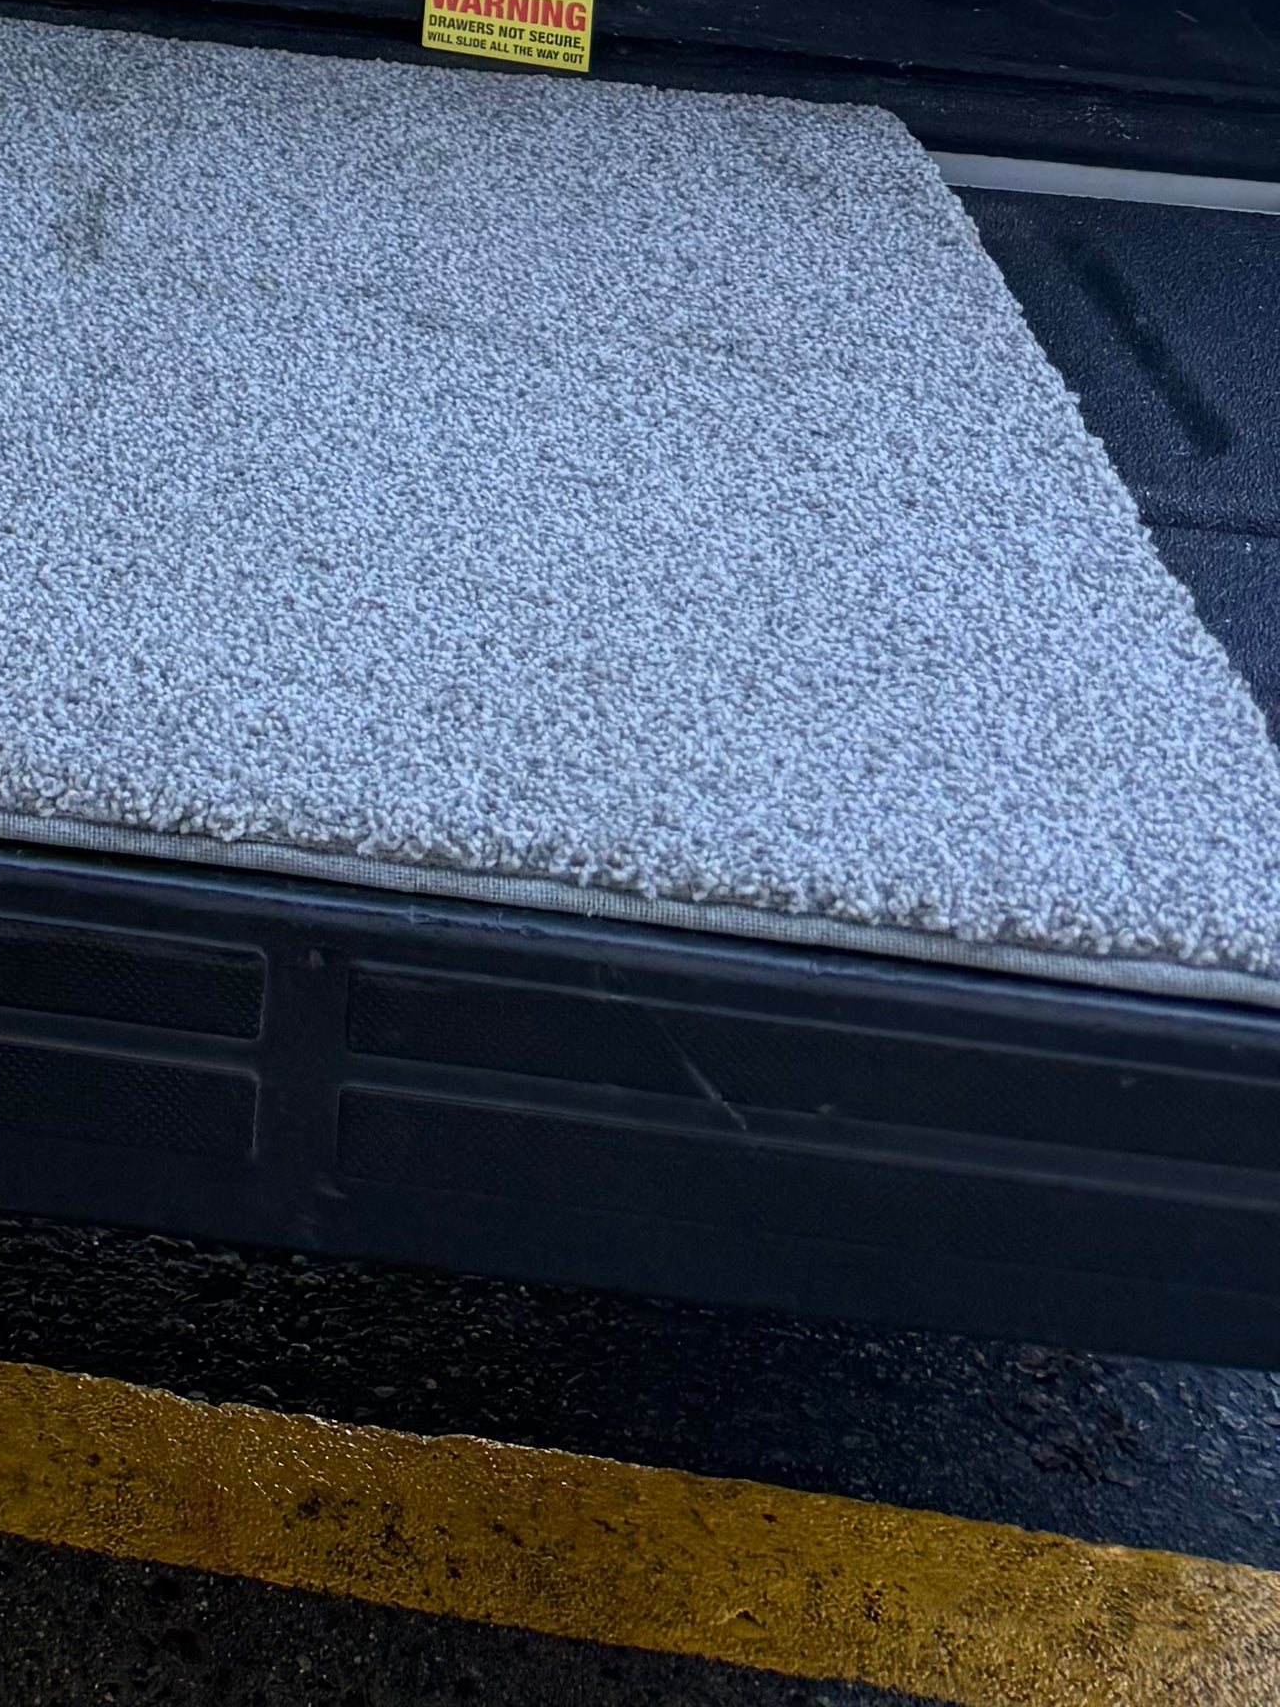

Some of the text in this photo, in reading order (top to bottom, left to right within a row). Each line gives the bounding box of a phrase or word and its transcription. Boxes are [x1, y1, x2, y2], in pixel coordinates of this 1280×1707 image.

[427, 30, 584, 65] WILL SLIDE ALL THE WAY OUT
[429, 14, 585, 52] DRAWERS NOT SECURE,
